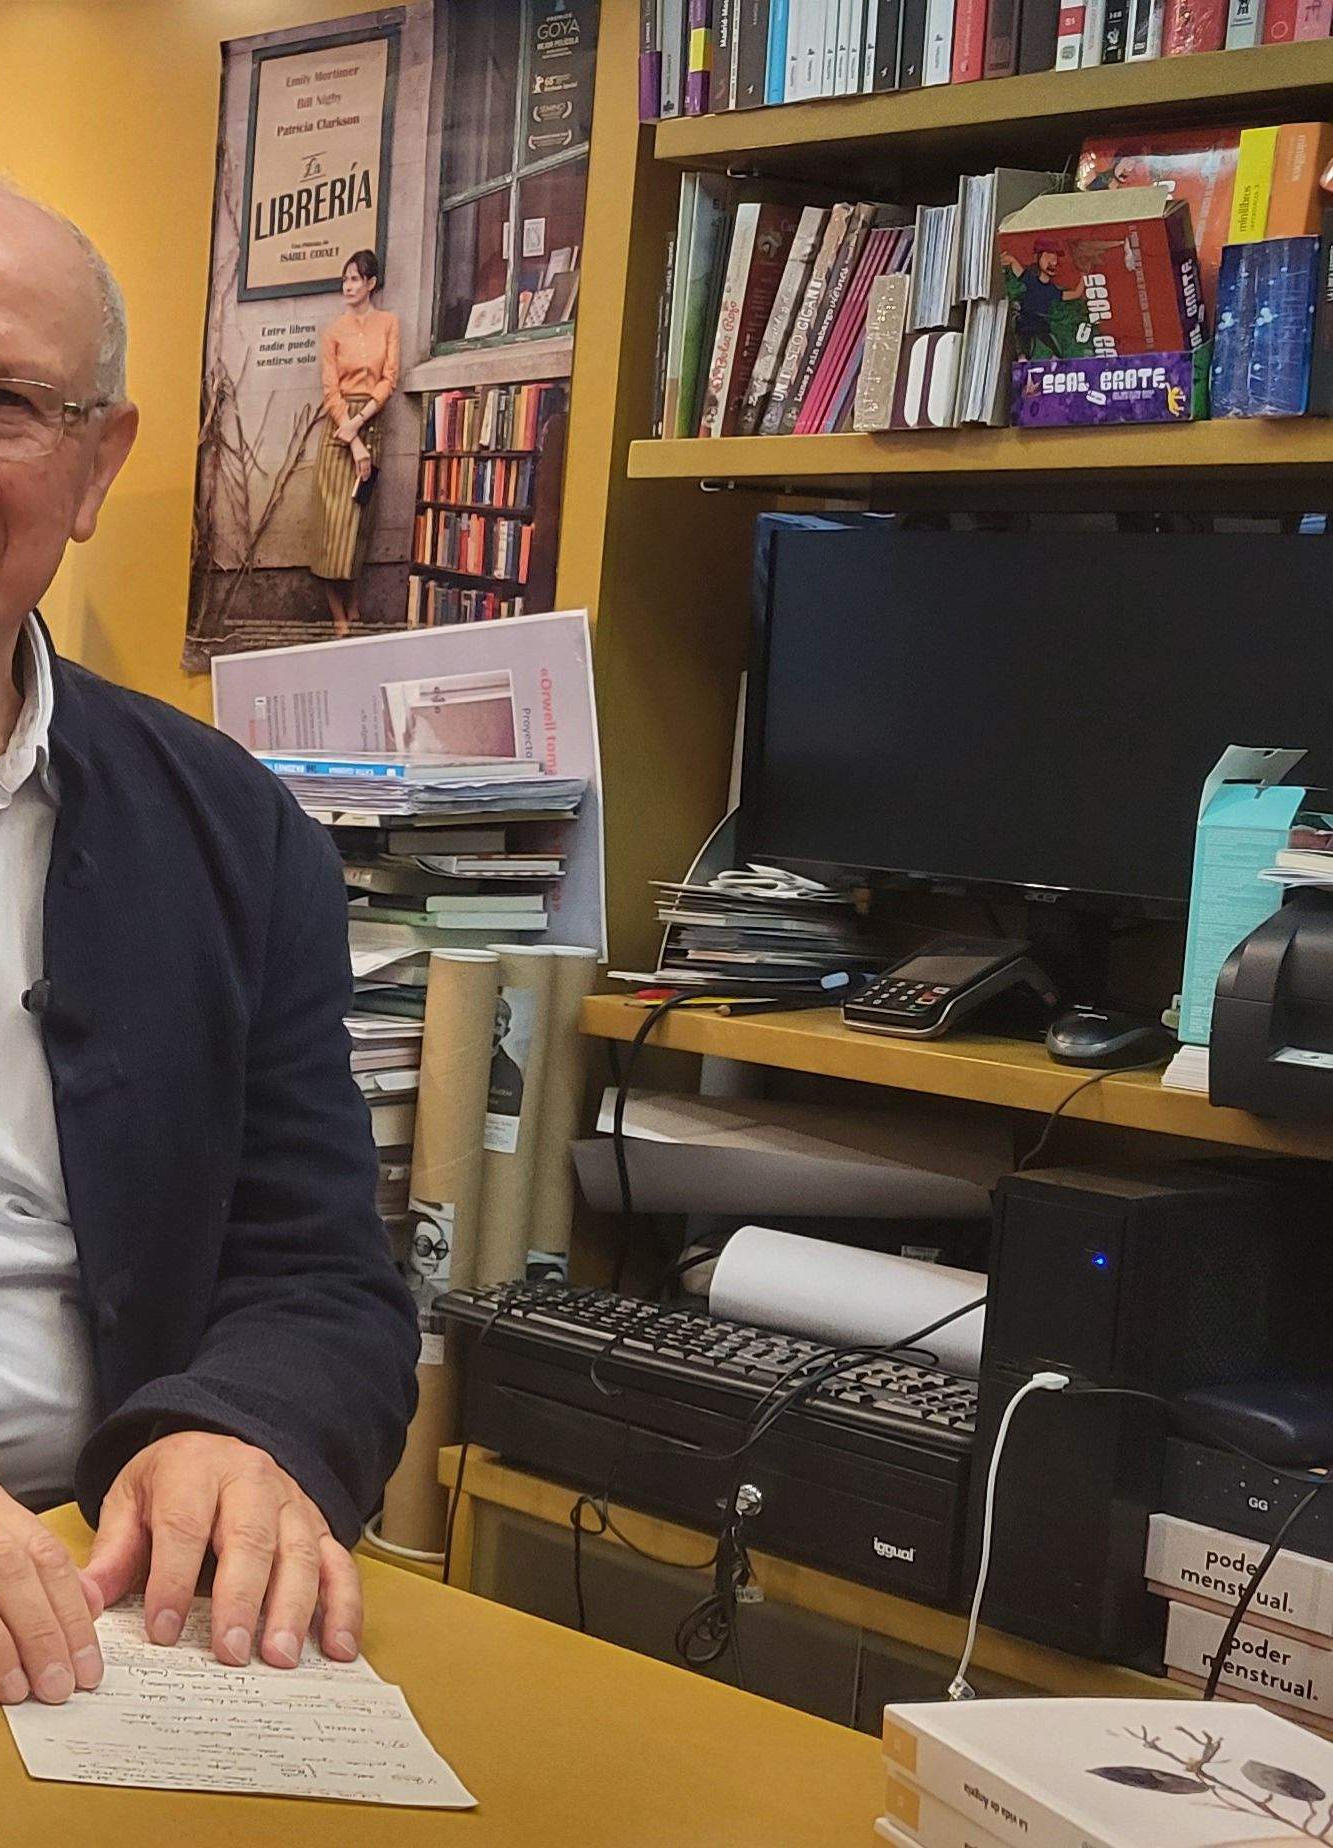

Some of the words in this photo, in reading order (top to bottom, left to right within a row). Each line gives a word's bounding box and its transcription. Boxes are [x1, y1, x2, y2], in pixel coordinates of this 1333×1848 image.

[537, 18, 580, 39] GOYA
[285, 74, 311, 88] Emily
[314, 66, 359, 82] Mortimer
[296, 97, 313, 110] Bill
[277, 120, 314, 137] Patricia
[316, 115, 360, 130] Clarkson
[254, 161, 373, 242] LIBRERÍA
[280, 250, 306, 263] ISABEL
[309, 247, 340, 259] COIXET
[261, 326, 286, 337] Entre
[289, 324, 316, 335] libros
[259, 341, 285, 352] nadie
[287, 340, 316, 352] puede
[256, 356, 294, 367] sentirse
[296, 355, 317, 364] solo
[522, 707, 533, 759] Proyecto
[1248, 1496, 1269, 1512] GG
[873, 1536, 914, 1562] iggual
[1206, 1550, 1259, 1577] pode
[1180, 1568, 1294, 1614] menstual.
[1229, 1637, 1292, 1666] poder
[990, 1800, 1000, 1814] de
[1001, 1807, 1017, 1823] vida
[1018, 1818, 1028, 1833] La
